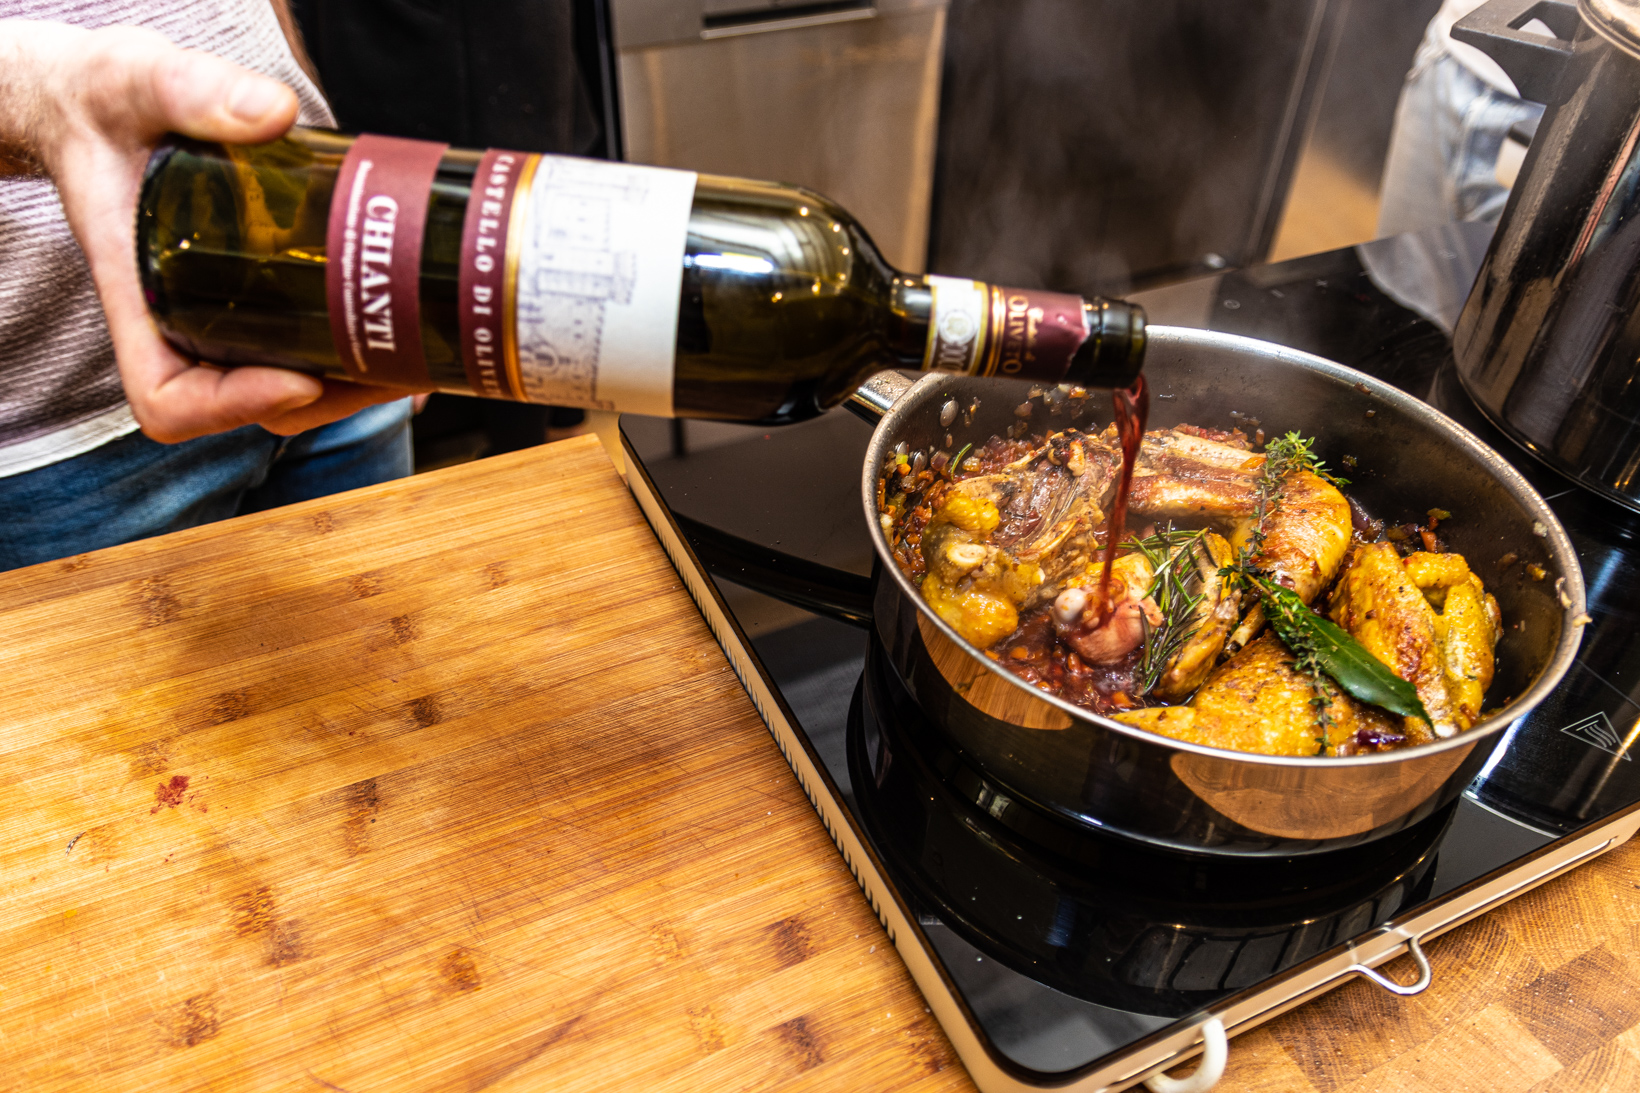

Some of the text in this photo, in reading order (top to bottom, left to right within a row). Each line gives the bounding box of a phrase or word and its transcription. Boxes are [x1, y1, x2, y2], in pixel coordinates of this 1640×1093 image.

[361, 195, 399, 352] CHIANTI
[472, 154, 514, 395] CASTELLO DI OLIVET
